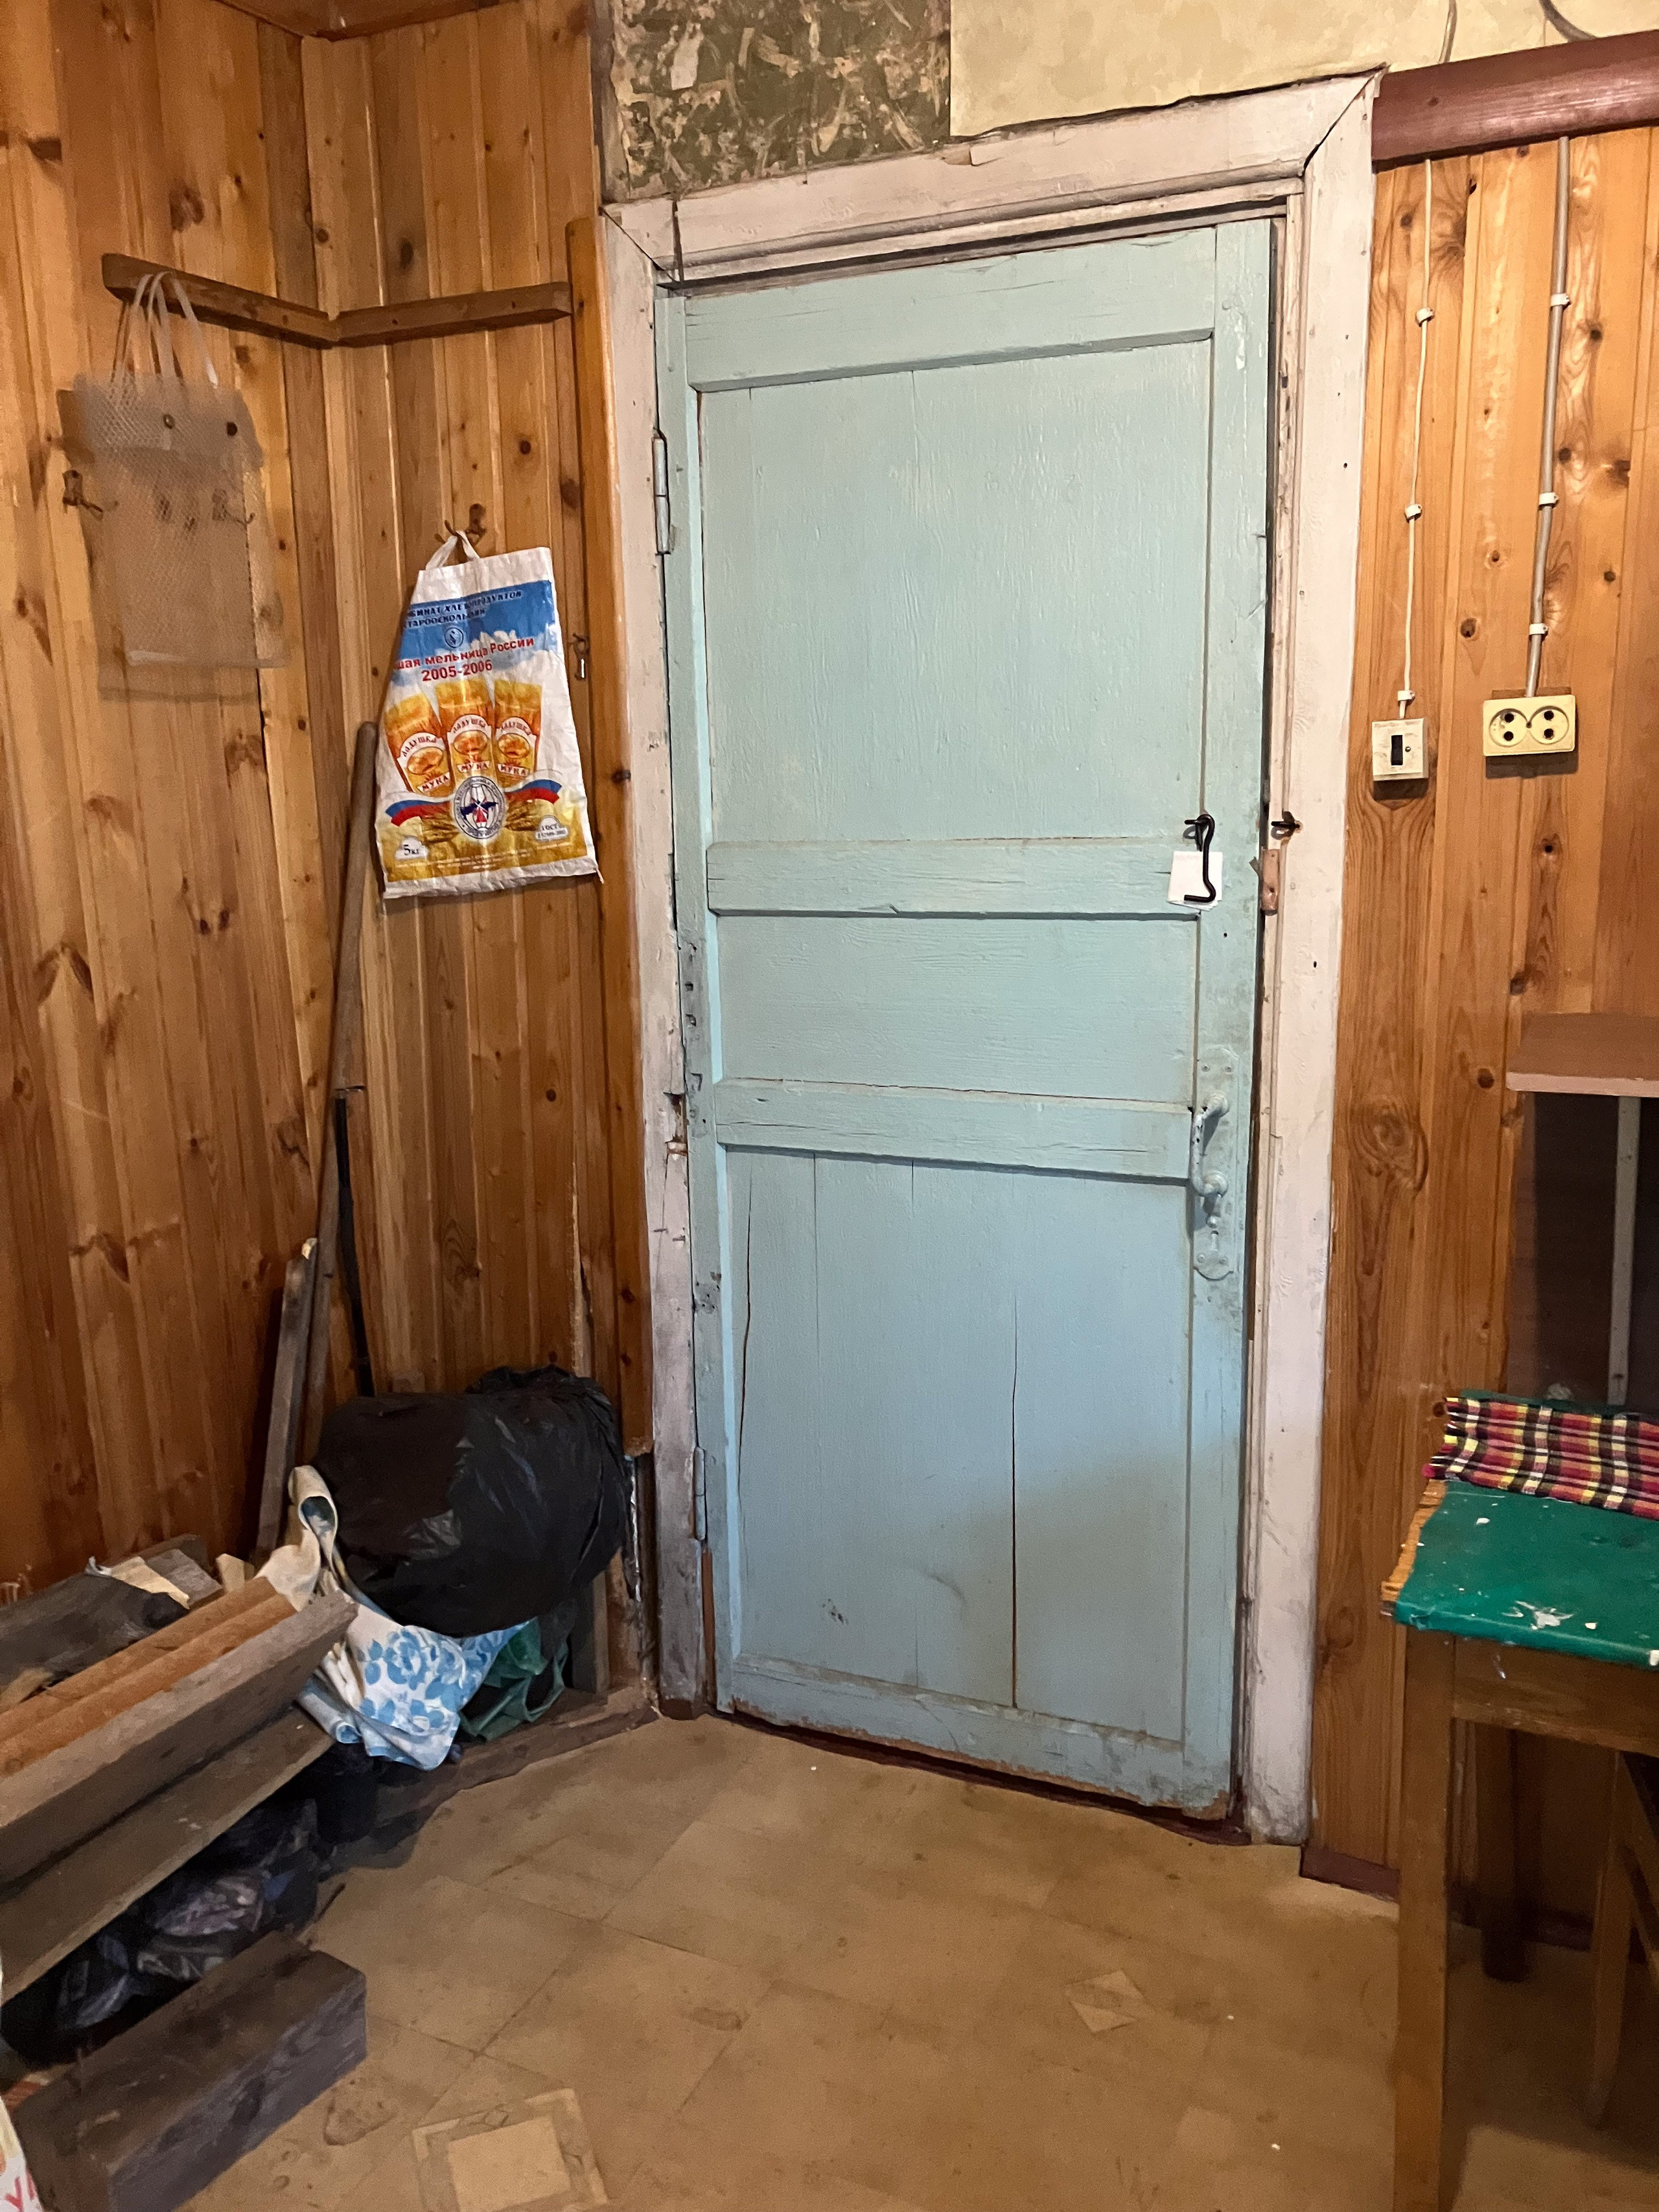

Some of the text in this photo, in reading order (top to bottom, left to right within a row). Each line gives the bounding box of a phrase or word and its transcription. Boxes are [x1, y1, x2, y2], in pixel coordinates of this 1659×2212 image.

[425, 648, 488, 665] мельница
[490, 638, 534, 653] России
[421, 659, 493, 681] 2005-2006
[422, 775, 449, 790] МУКА
